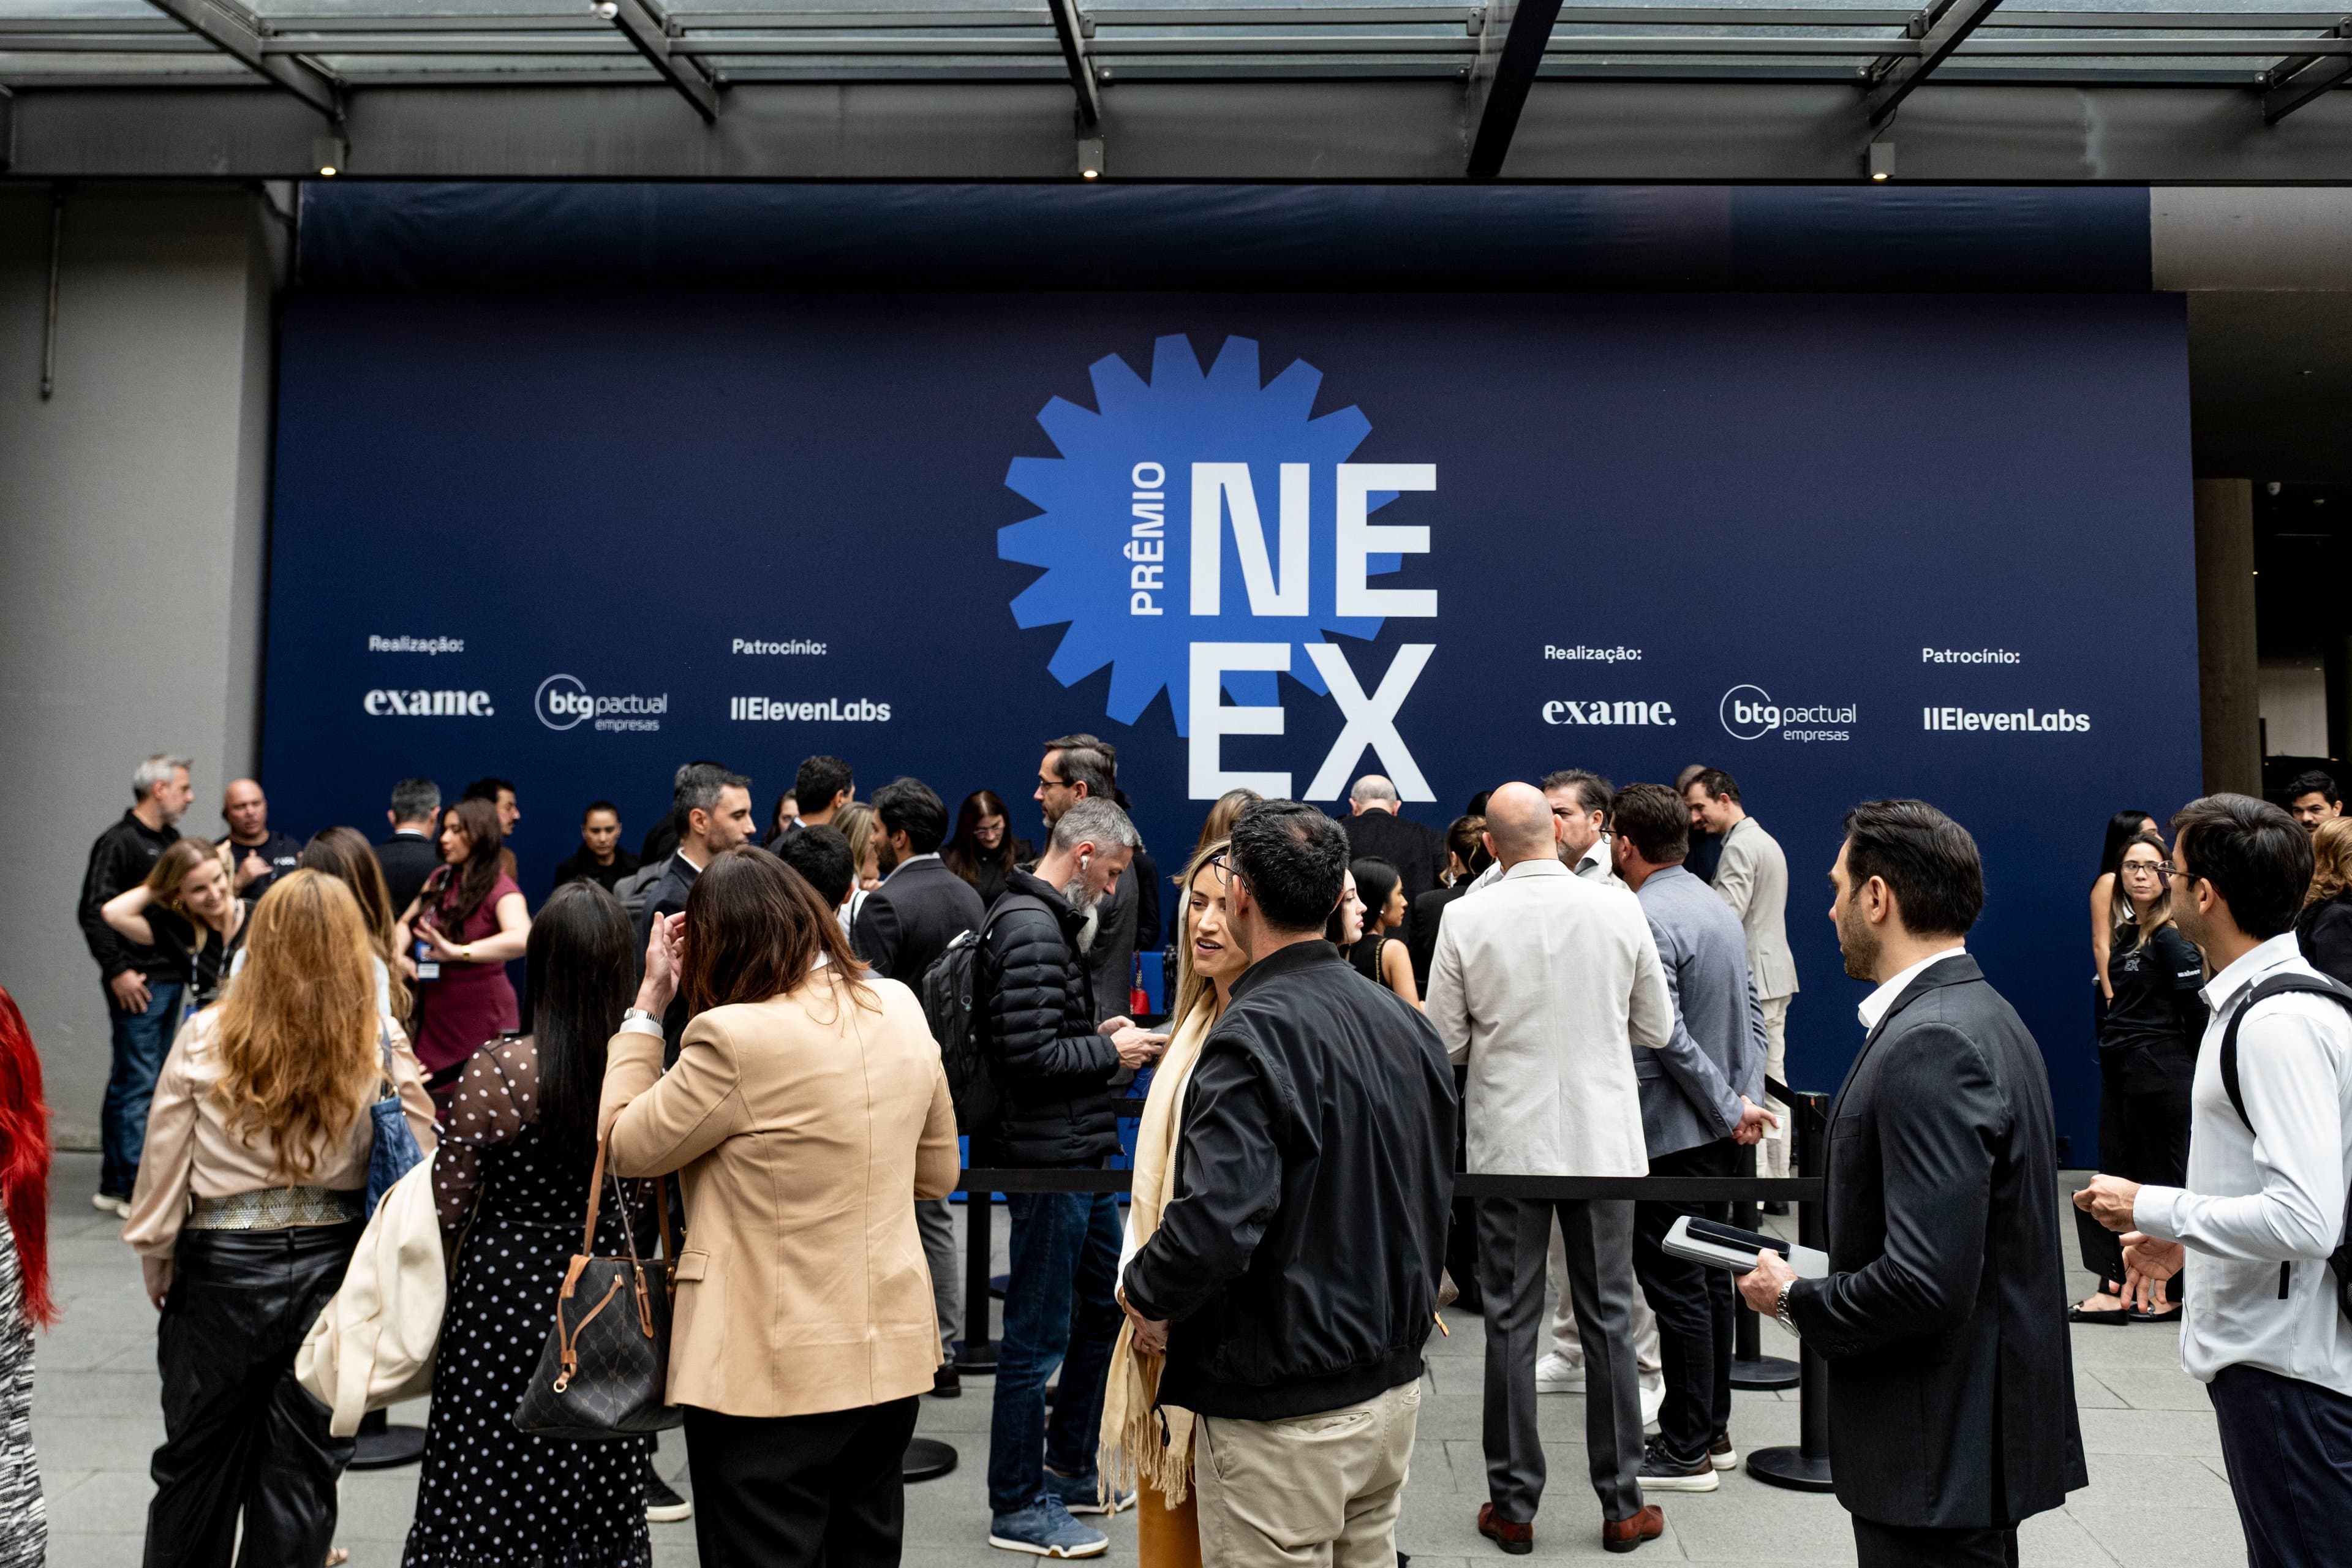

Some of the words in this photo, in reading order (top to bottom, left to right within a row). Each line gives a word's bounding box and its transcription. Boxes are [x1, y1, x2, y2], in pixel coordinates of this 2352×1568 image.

[1123, 461, 1166, 616] PRÊMIO
[1189, 462, 1438, 617] NE
[369, 635, 464, 655] Realização:
[732, 638, 827, 656] Patrocínio:
[1544, 644, 1642, 664] Realização:
[1922, 647, 2021, 664] Patrocínio:
[364, 689, 494, 717] exame.
[1542, 700, 1676, 726] exame.
[594, 718, 660, 733] empresas
[1188, 641, 1438, 802] EX
[1783, 730, 1850, 743] empresas
